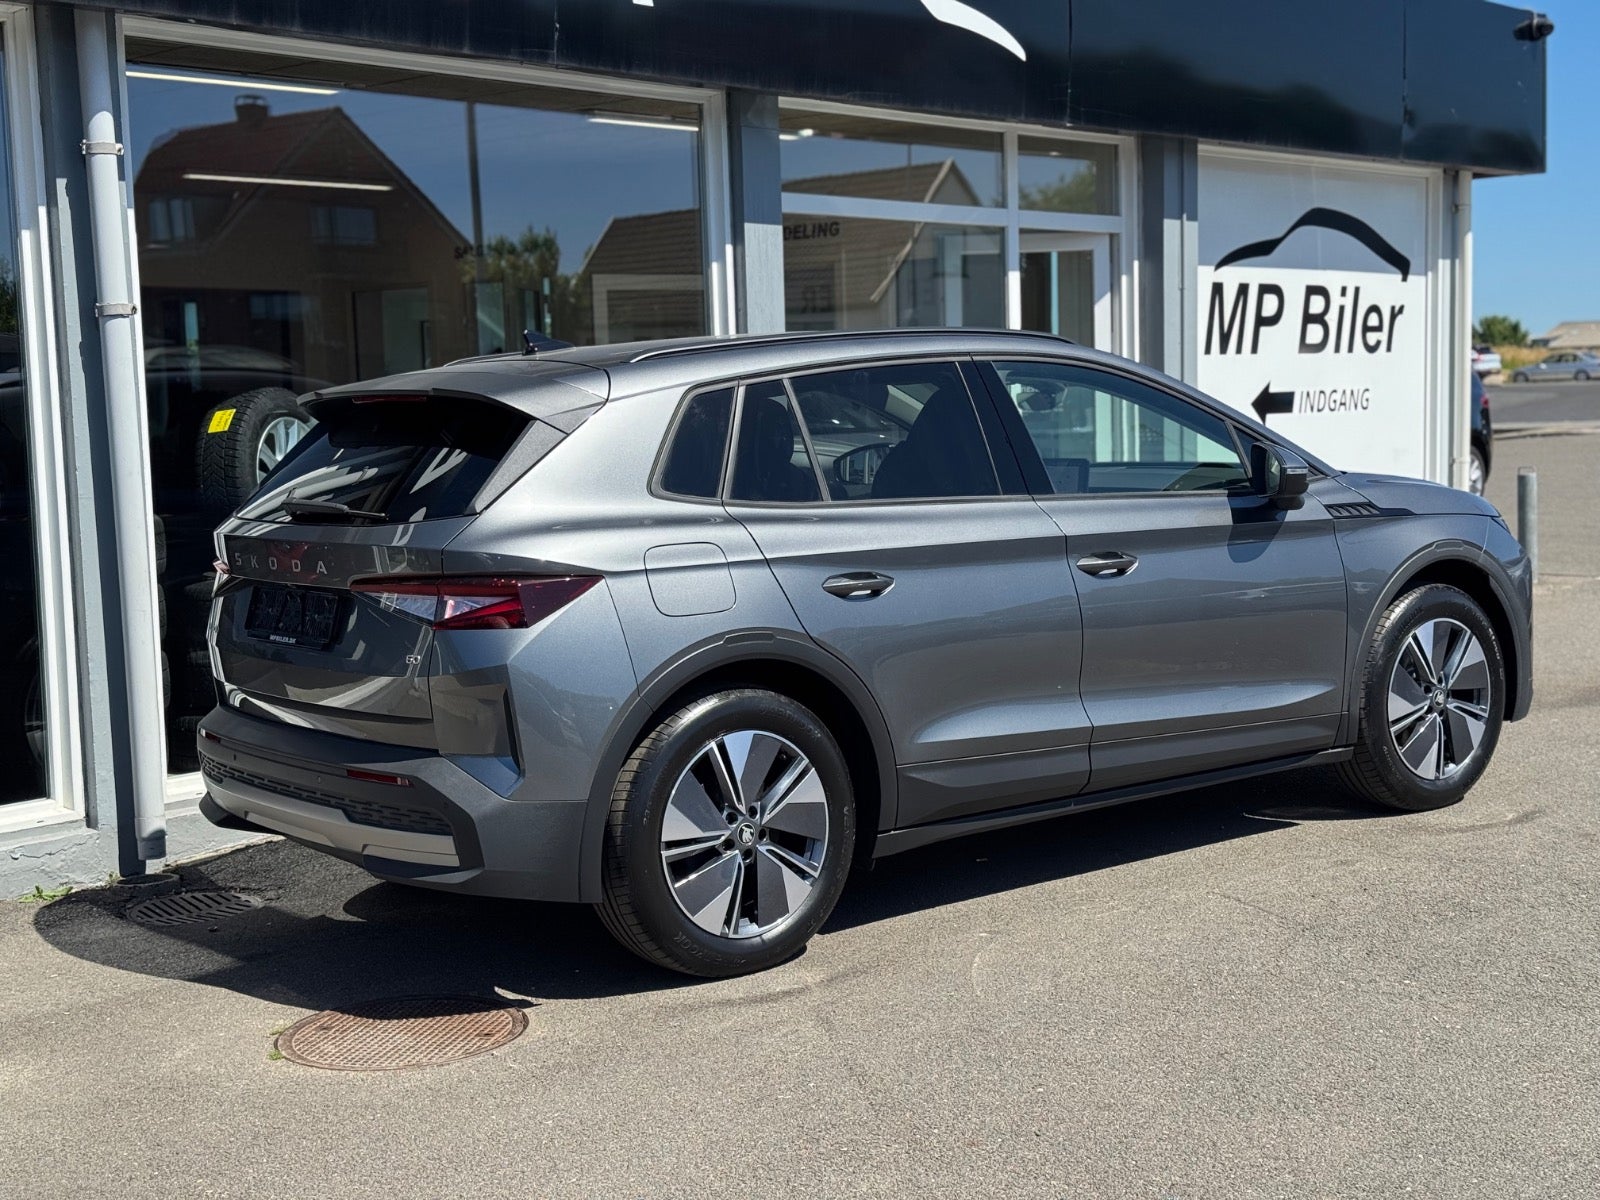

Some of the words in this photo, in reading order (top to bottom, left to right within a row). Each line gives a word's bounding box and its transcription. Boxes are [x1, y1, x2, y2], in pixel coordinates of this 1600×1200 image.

[1203, 281, 1285, 355] MP
[1298, 284, 1405, 354] Biler
[1299, 388, 1370, 414] INDGANG
